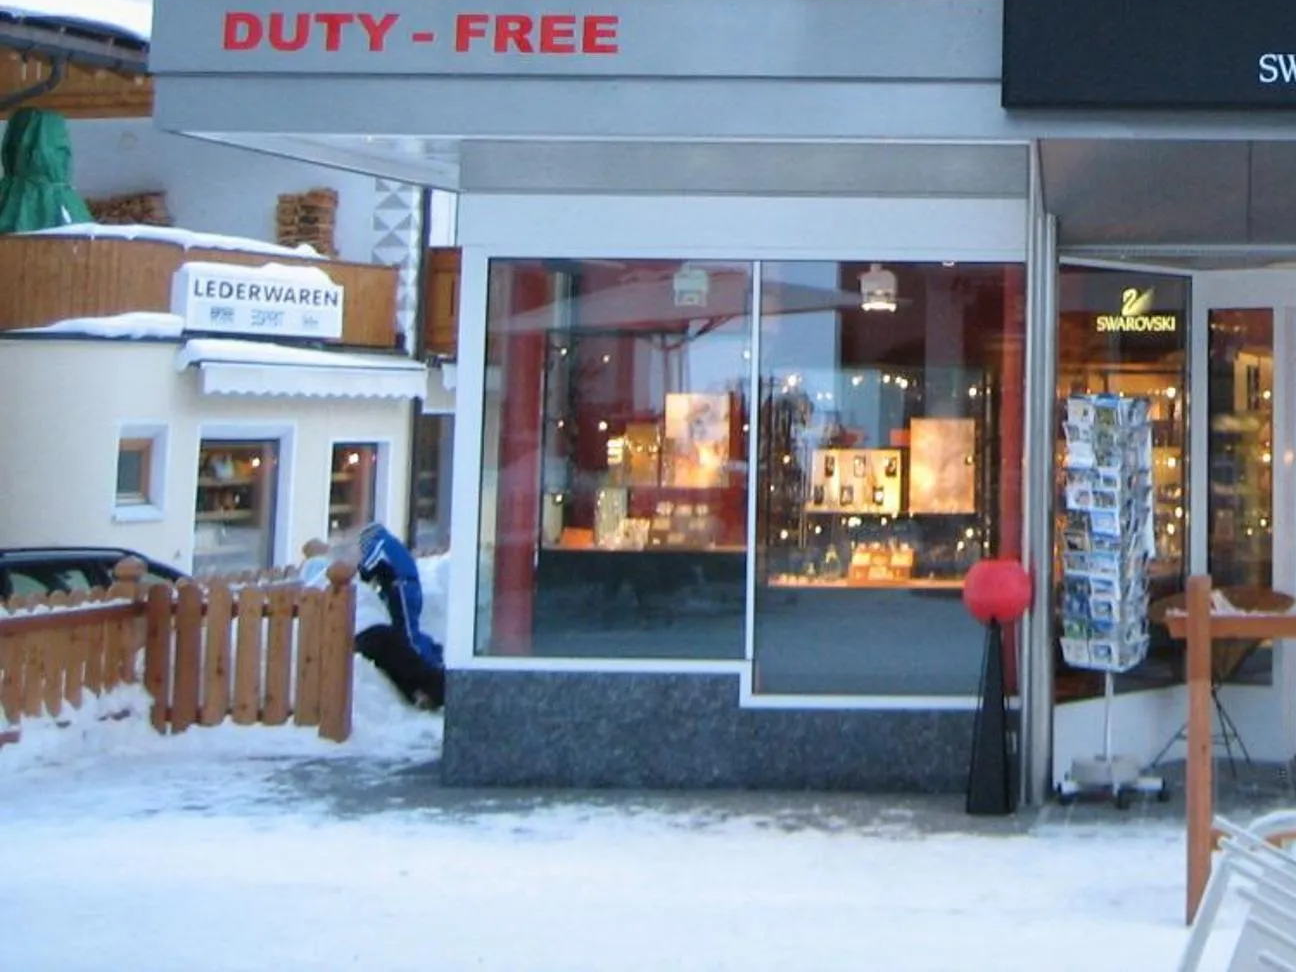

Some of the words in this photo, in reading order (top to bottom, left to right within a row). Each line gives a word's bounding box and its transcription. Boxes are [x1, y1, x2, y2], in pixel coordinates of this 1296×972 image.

[223, 12, 401, 52] DUTY
[455, 14, 620, 54] FREE
[193, 278, 339, 308] LEDERWAREN
[1096, 315, 1177, 332] SWAROVSKI
